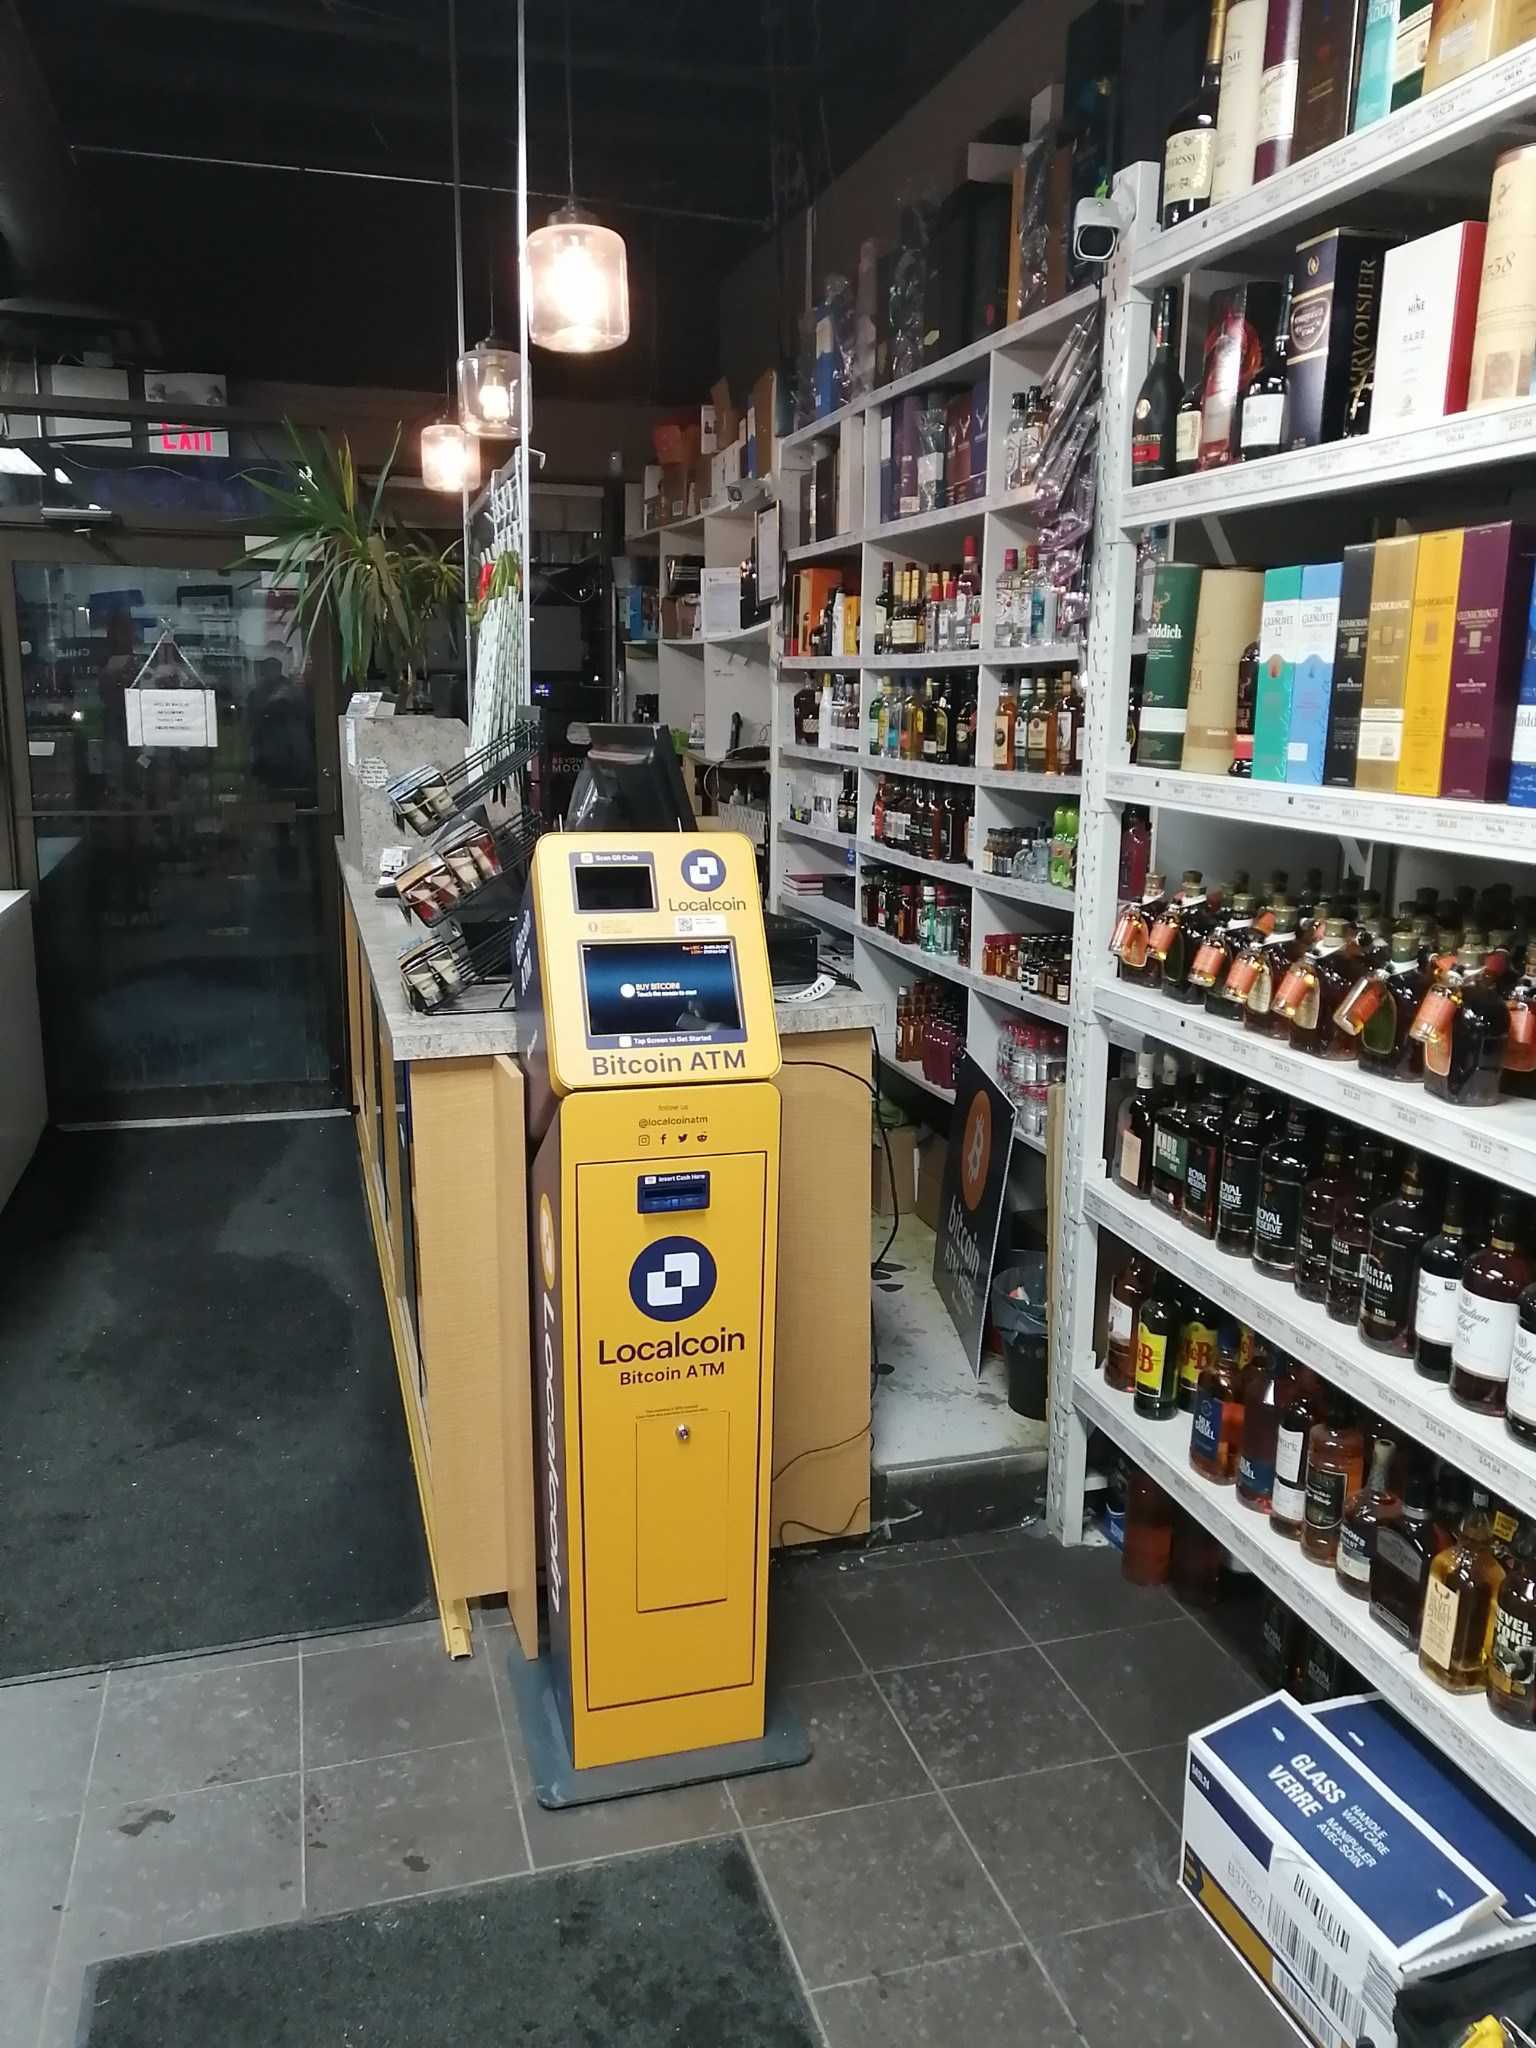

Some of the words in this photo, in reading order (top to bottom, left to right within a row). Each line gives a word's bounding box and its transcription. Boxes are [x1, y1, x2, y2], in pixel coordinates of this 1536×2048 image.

[668, 897, 747, 912] Localcoin
[688, 1034, 712, 1043] Started
[592, 1053, 682, 1076] Bitcoin
[690, 1049, 746, 1072] ATM
[638, 1115, 709, 1129] @localcoinatm
[675, 1174, 692, 1182] Cash
[947, 1194, 980, 1281] bitcoin
[599, 1326, 746, 1366] Localcoin
[619, 1367, 681, 1386] Bitcoin
[686, 1361, 726, 1379] ATM
[543, 1291, 562, 1614] Localcoin
[1267, 1763, 1324, 1818] VERRE
[1290, 1753, 1347, 1804] GLASS
[1325, 1816, 1378, 1868] MANIPULER
[1341, 1808, 1366, 1833] WITH
[1363, 1830, 1391, 1857] CARE
[1350, 1804, 1388, 1841] HANDLE
[1316, 1822, 1342, 1847] AVEC
[1339, 1843, 1364, 1869] SOIN
